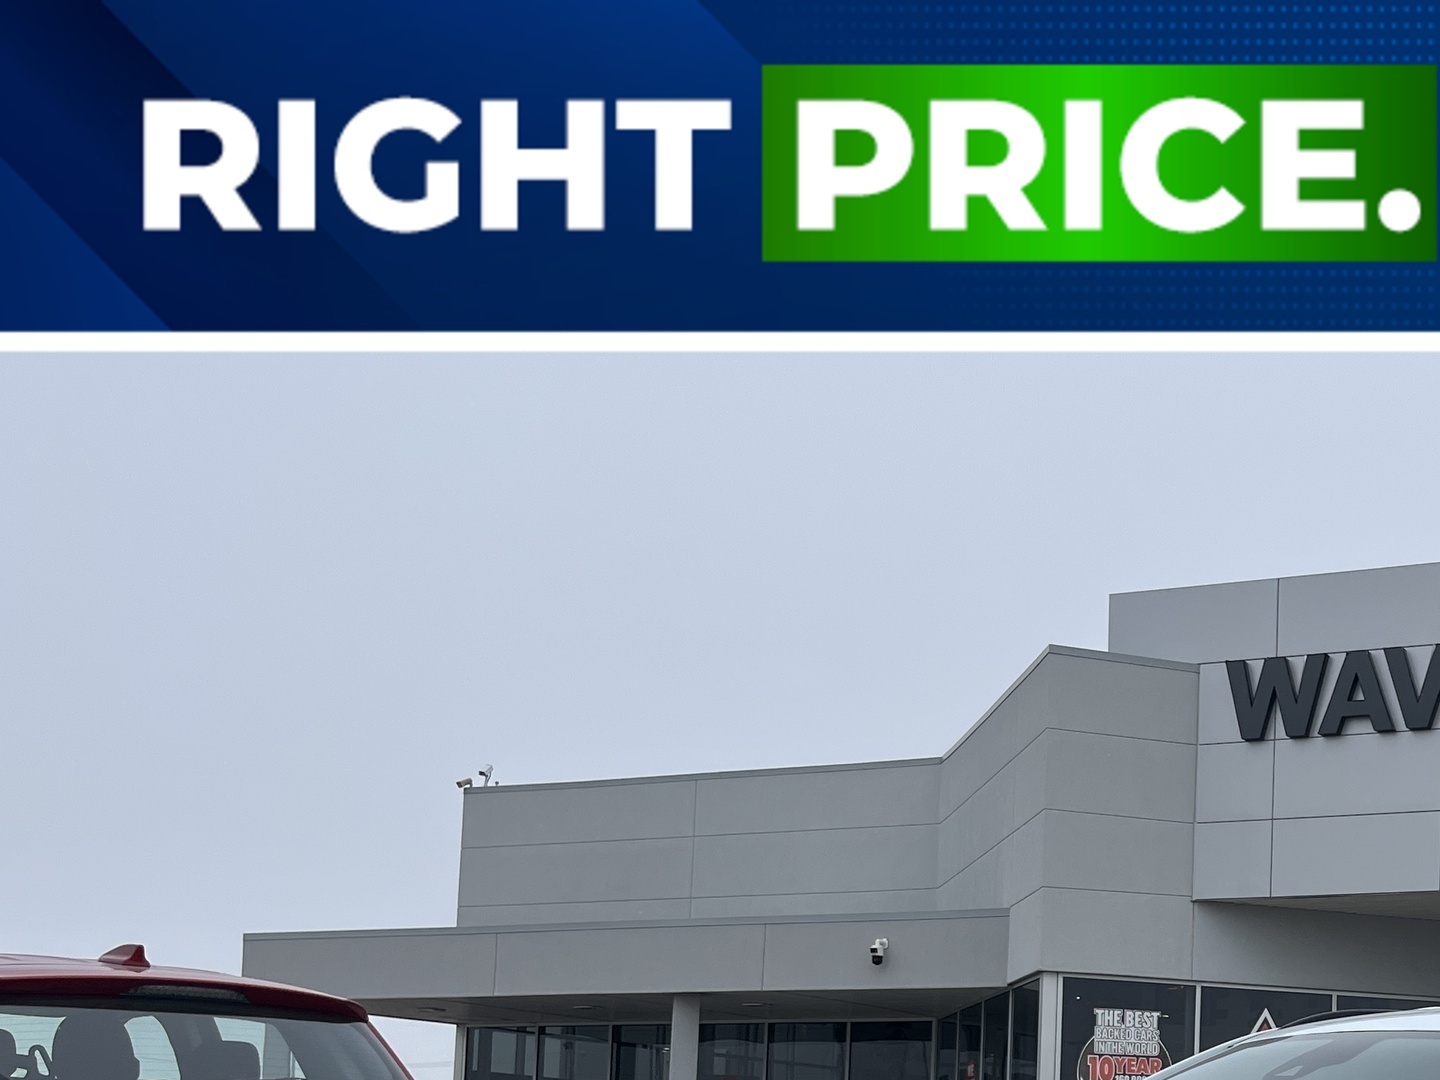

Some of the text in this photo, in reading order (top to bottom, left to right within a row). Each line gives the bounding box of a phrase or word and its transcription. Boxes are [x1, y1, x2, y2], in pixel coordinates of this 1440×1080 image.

[1095, 1009, 1160, 1029] THE BEST
[1095, 1028, 1160, 1041] BACKED CARS
[1095, 1041, 1160, 1055] IN THE WORLD
[1114, 1056, 1162, 1074] YEAR
